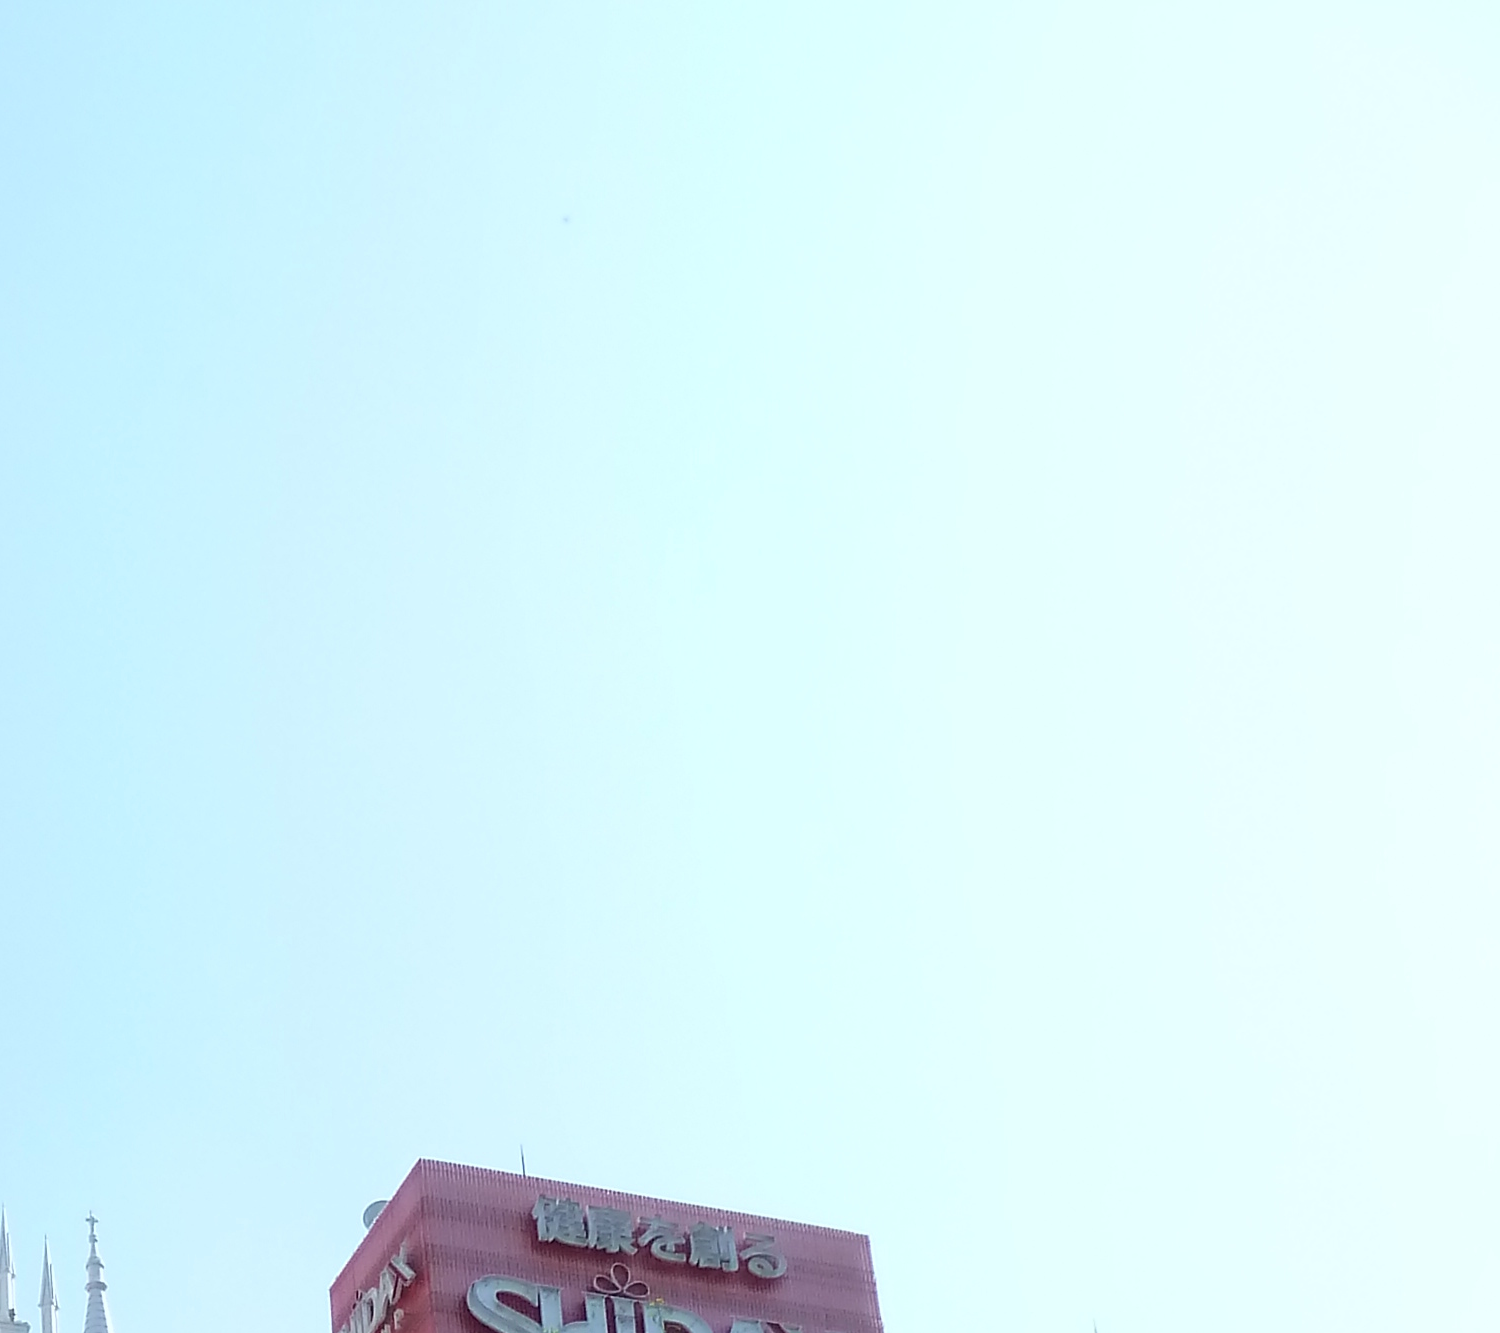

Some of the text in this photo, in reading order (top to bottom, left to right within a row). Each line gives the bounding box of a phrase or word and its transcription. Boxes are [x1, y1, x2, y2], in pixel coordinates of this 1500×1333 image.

[530, 1195, 788, 1280] 健康を創る
